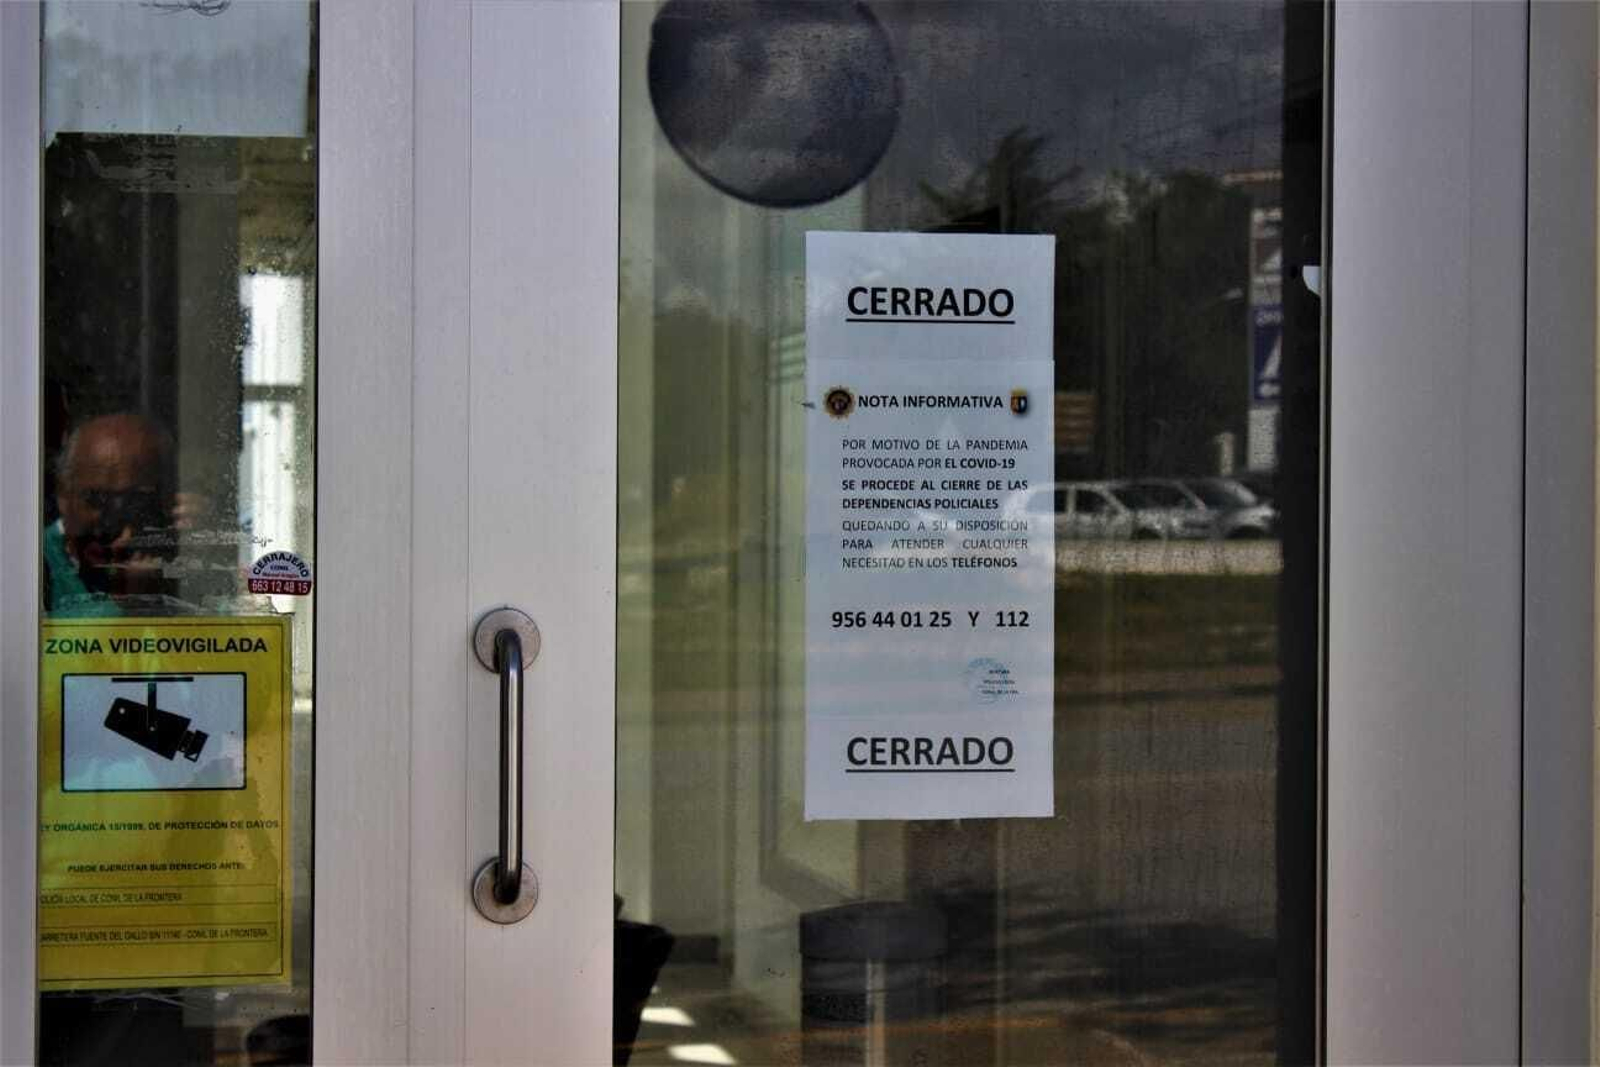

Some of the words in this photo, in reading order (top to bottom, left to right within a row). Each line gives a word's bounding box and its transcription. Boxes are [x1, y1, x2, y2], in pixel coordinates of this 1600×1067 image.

[847, 286, 1014, 317] CERRADO
[858, 395, 899, 408] NOTA
[903, 395, 1003, 408] INFORMATIVA
[842, 439, 866, 450] POR
[872, 439, 920, 450] MOTIVO
[926, 439, 940, 450] DE
[947, 439, 960, 450] LA
[966, 439, 1028, 450] PANDEMIA
[842, 457, 914, 469] PROVOCADA
[918, 457, 942, 469] POR
[945, 457, 957, 469] EL
[960, 457, 1016, 469] COVID-19
[842, 480, 855, 491] SE
[861, 480, 916, 491] PROCEDE
[920, 480, 935, 491] AL
[941, 480, 981, 491] CIERRE
[987, 480, 1001, 491] DE
[1008, 480, 1028, 491] LAS
[842, 498, 932, 510] DEPENDENCIAS
[934, 498, 999, 510] POLICIALES
[842, 519, 911, 532] QUEDANDO
[917, 520, 926, 531] A
[932, 520, 948, 531] SU
[842, 538, 873, 550] PARA
[891, 538, 945, 550] ATENDER
[962, 538, 1028, 551] CUALQUIER
[253, 552, 309, 578] CERRAJERO
[908, 557, 925, 569] EN
[927, 557, 948, 569] LOS
[952, 555, 1017, 569] TELÉFONOS
[252, 580, 269, 592] 663
[271, 581, 282, 593] 12
[284, 581, 295, 593] 48
[298, 582, 308, 594] 15
[832, 611, 867, 628] 956
[872, 611, 896, 628] 44
[900, 611, 923, 628] 01
[929, 611, 952, 628] 25
[968, 611, 980, 628] Y
[996, 611, 1030, 628] 112
[45, 638, 103, 654] ZONA
[109, 637, 268, 653] VIDEOVIGILADA
[847, 736, 1014, 766] CERRADO
[148, 821, 163, 831] DE
[164, 819, 228, 830] PROTECCIÓN
[231, 820, 244, 830] DE
[67, 864, 97, 873] PUEDE
[99, 863, 148, 872] EJERCITAR
[150, 862, 167, 871] SUS
[169, 861, 217, 871] DERECHOS
